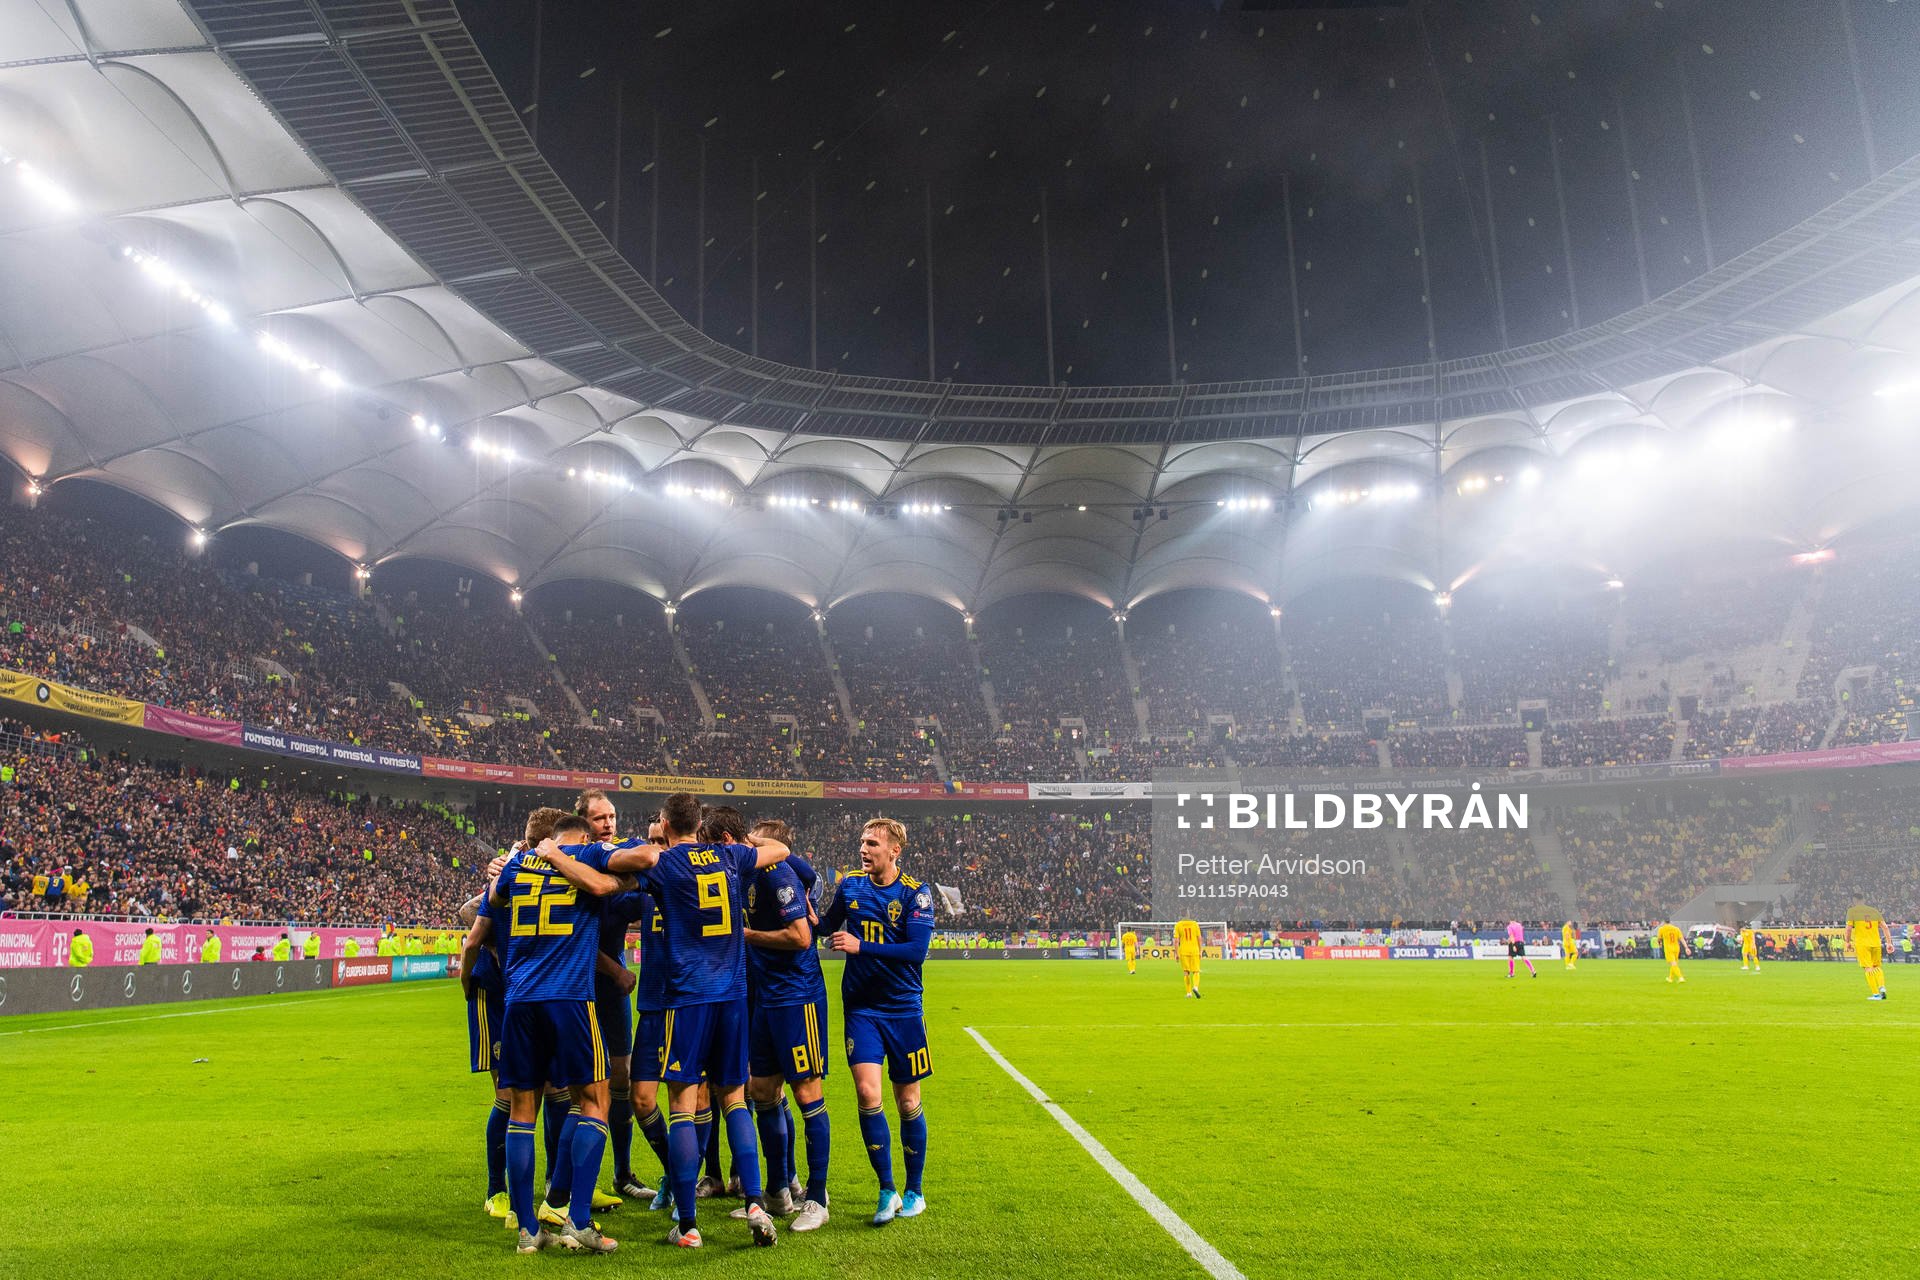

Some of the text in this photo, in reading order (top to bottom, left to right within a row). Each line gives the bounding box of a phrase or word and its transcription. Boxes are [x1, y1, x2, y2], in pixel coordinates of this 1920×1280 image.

[511, 873, 577, 936] 22
[696, 871, 732, 937] 9
[861, 920, 884, 944] 10
[1184, 928, 1192, 940] 11
[792, 1045, 809, 1073] 8
[907, 1047, 929, 1077] 10
